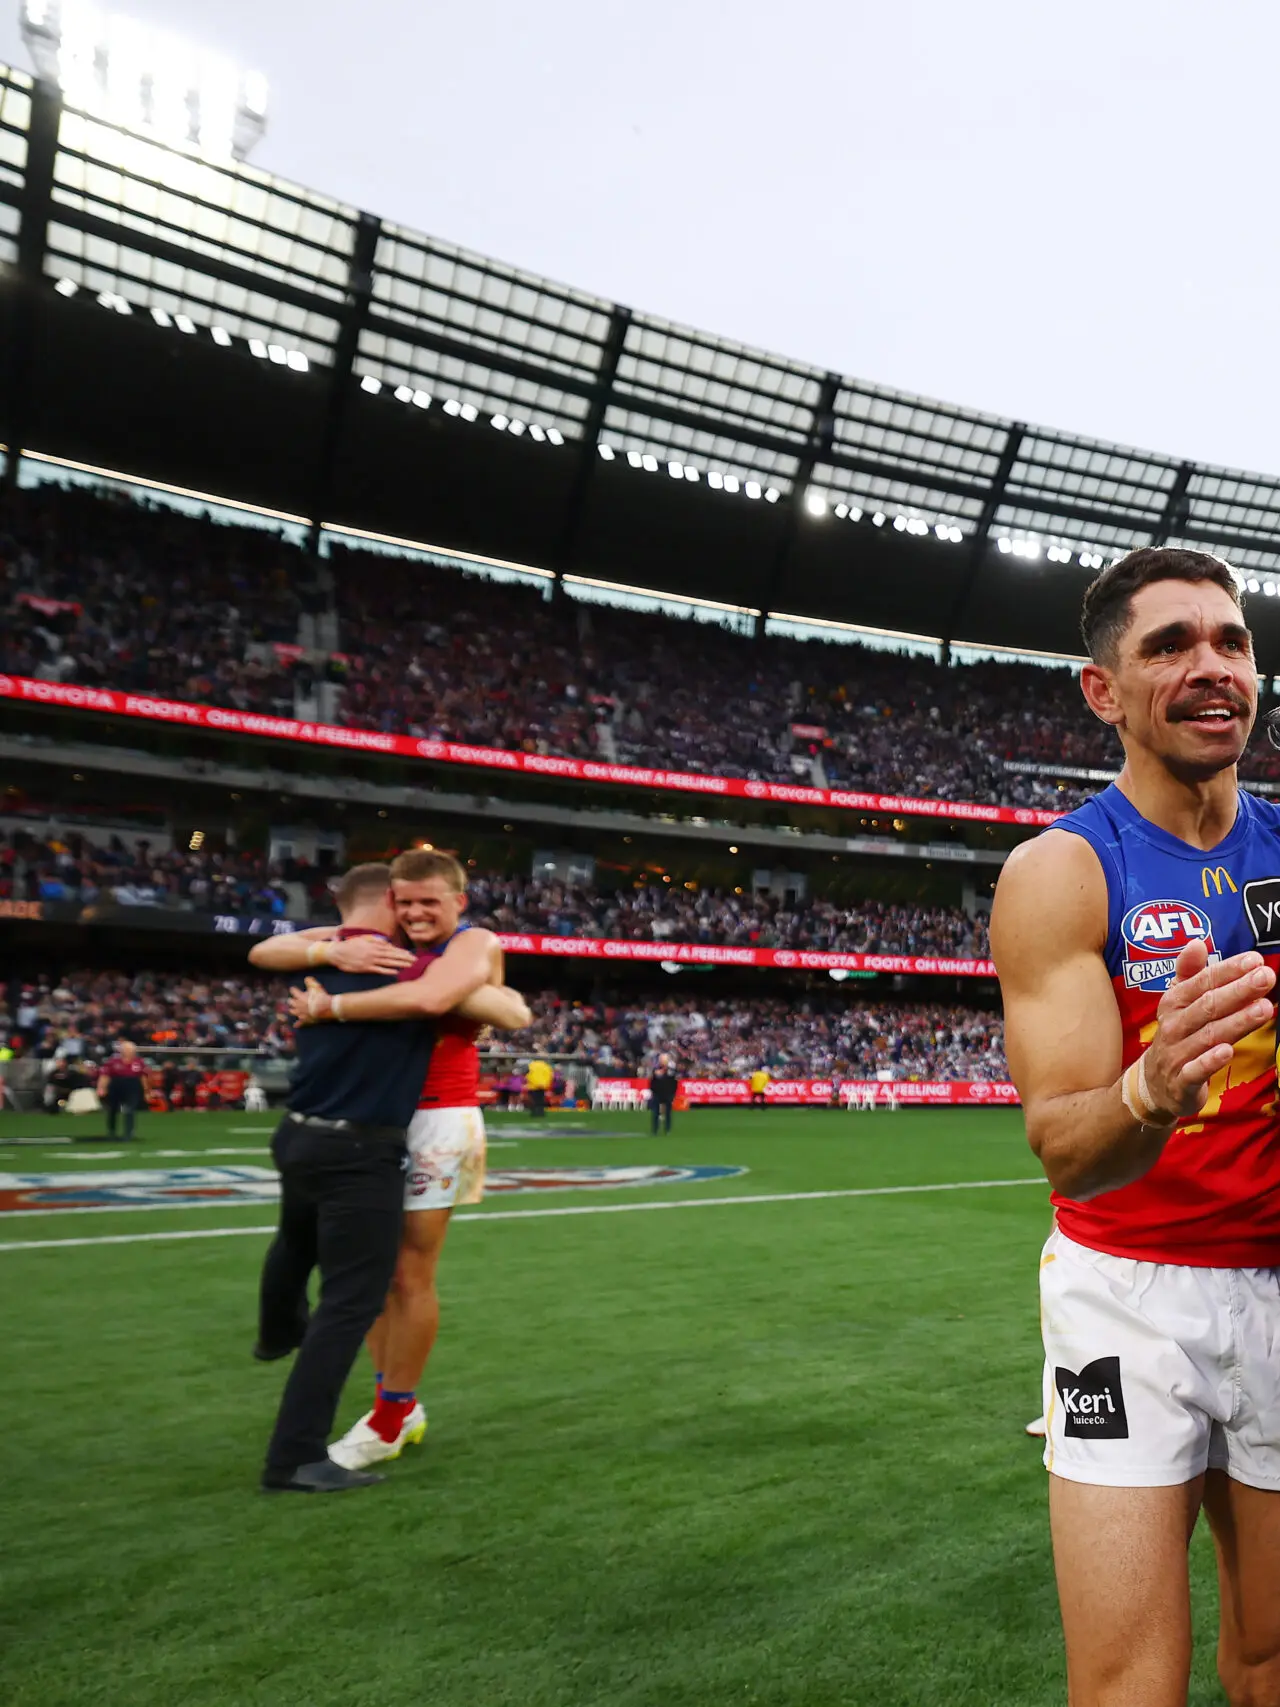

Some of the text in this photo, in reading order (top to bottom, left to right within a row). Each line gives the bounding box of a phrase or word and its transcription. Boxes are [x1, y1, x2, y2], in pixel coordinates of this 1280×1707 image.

[20, 679, 117, 709] TOYOTA
[206, 709, 239, 726] OH
[242, 715, 299, 735] WHAT
[300, 723, 315, 737] A
[316, 725, 395, 750] FEELING!
[450, 744, 518, 767] TOYOTA
[583, 763, 609, 777] OH
[609, 766, 653, 784] WHAT
[652, 772, 665, 784] A
[666, 772, 728, 792] FEELING!
[1004, 761, 1037, 773] REPORT
[770, 785, 823, 803] TOYOTA
[879, 797, 899, 810] OH
[900, 800, 938, 813] WHAT
[937, 804, 948, 814] A
[949, 804, 999, 820] FEELING!
[1133, 911, 1206, 942] AFL
[604, 942, 629, 956] OH
[630, 944, 677, 960] WHAT
[677, 947, 691, 959] A
[691, 947, 756, 964] FEELING!
[800, 952, 857, 968] TOYOTA
[915, 960, 936, 972] OH
[937, 961, 976, 974] WHAT
[976, 963, 987, 974] A
[1128, 959, 1175, 983] GRAND
[683, 1081, 748, 1096] TOYOTA
[764, 1082, 807, 1096] OOTY.
[893, 1083, 951, 1097] FEELING!
[1062, 1387, 1116, 1413] Keri
